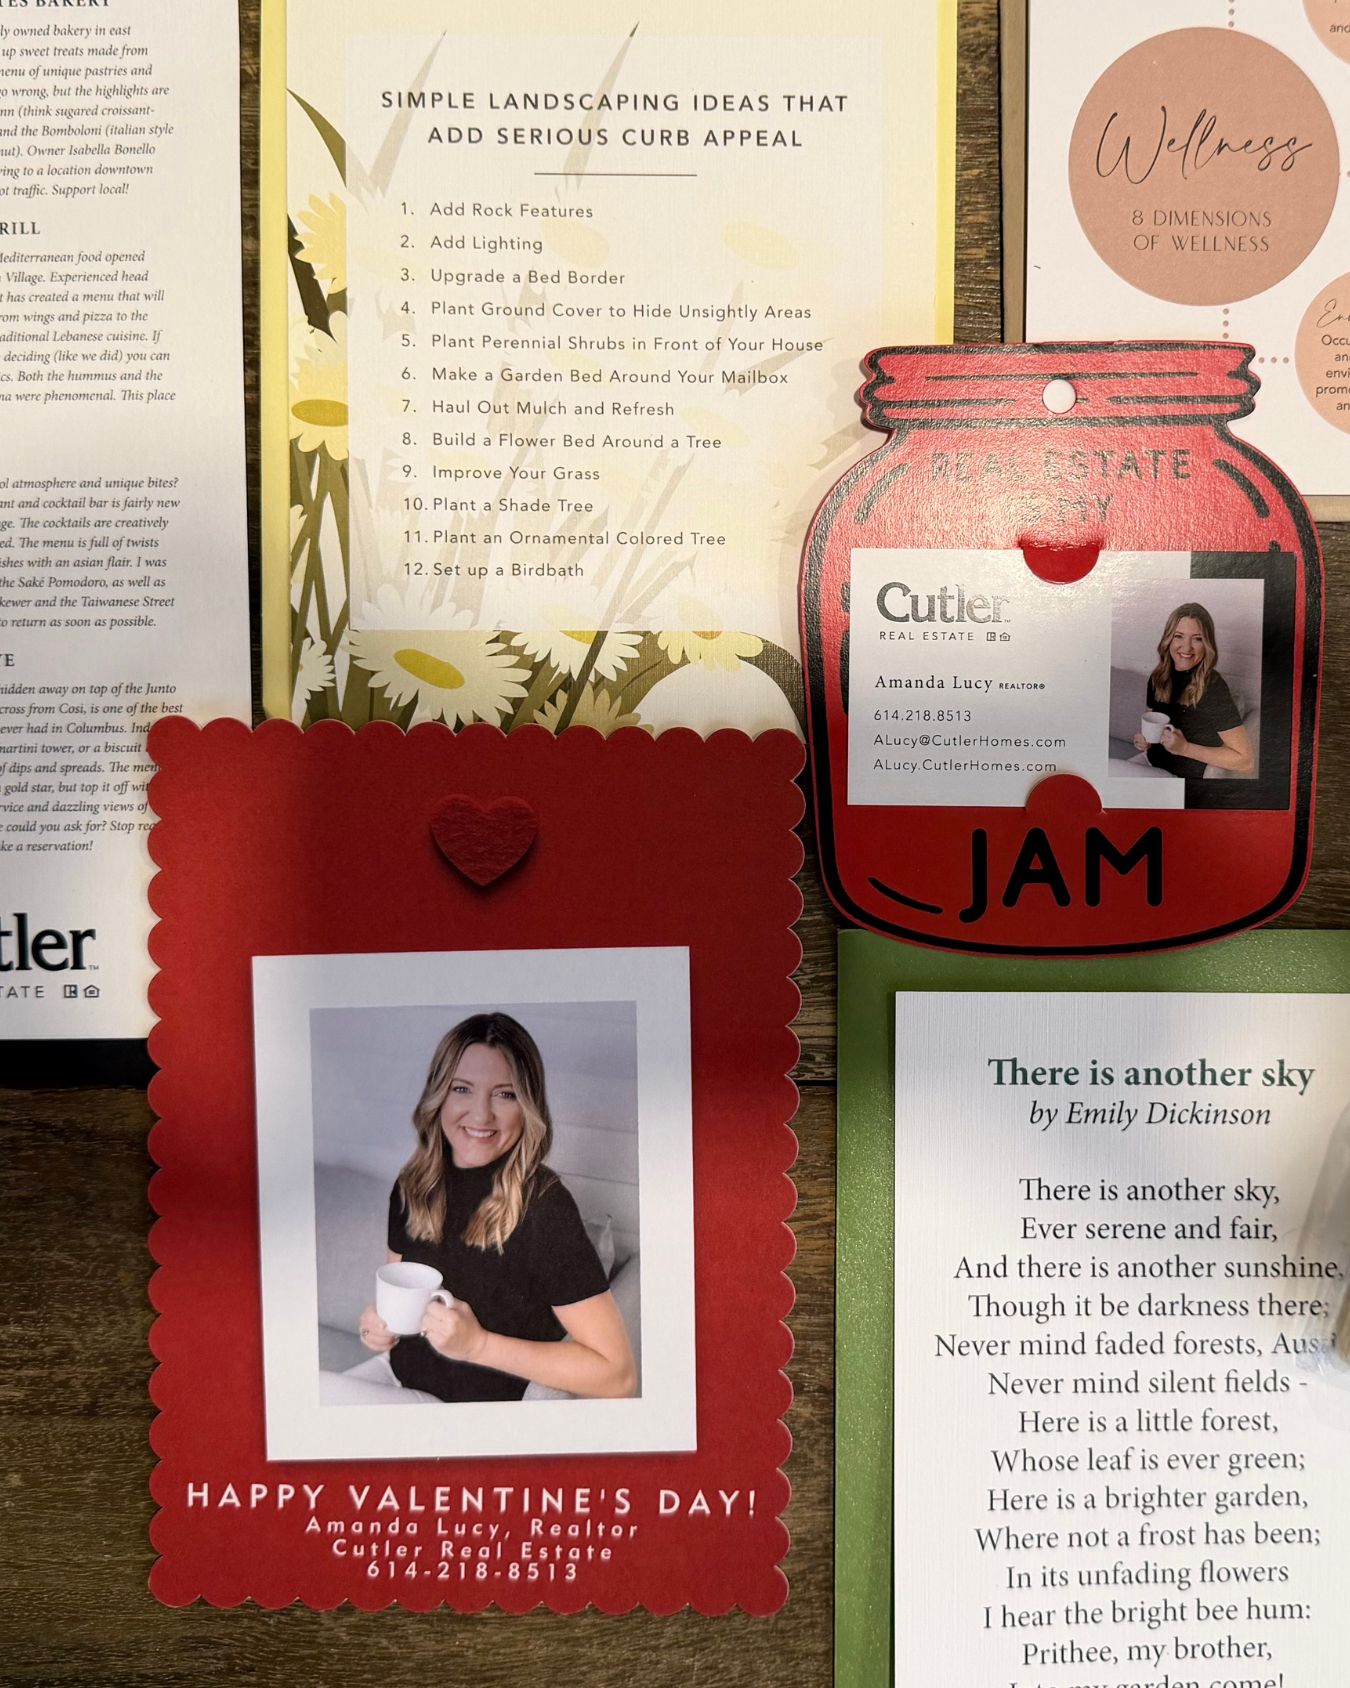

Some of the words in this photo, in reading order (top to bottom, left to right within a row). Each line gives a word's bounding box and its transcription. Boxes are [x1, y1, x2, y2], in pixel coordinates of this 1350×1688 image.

[2, 47, 16, 60] up
[19, 46, 50, 57] sweet
[53, 46, 84, 56] treats
[87, 45, 119, 56] made
[119, 44, 148, 59] from
[381, 90, 474, 109] SIMPLE
[489, 92, 678, 111] LANDSCAPING
[693, 94, 769, 112] IDEAS
[782, 94, 847, 112] THAT
[427, 126, 482, 144] ADD
[497, 127, 608, 145] SERIOUS
[622, 128, 689, 146] CURB
[703, 129, 802, 147] APPEAL
[1095, 105, 1313, 184] Wellness
[401, 201, 414, 215] 1.
[429, 201, 464, 216] Add
[472, 202, 513, 217] Rock
[520, 203, 593, 218] Features
[1131, 208, 1144, 225] 8
[1153, 209, 1271, 227] DIMENSIONS
[400, 234, 414, 248] 2.
[430, 234, 465, 249] Add
[473, 235, 542, 254] Lighting
[1133, 233, 1159, 251] OF
[1171, 235, 1269, 252] WELLNESS
[400, 267, 415, 281] 3.
[431, 268, 505, 286] Upgrade
[512, 273, 521, 283] a
[528, 269, 560, 284] Bed
[568, 270, 625, 284] Border
[400, 300, 415, 314] 4.
[431, 300, 474, 315] Plant
[481, 301, 545, 316] Ground
[552, 302, 602, 317] Cover
[608, 305, 626, 317] to
[633, 303, 671, 318] Hide
[679, 303, 758, 322] Unsightly
[764, 304, 811, 318] Areas
[3, 350, 51, 365] deciding
[53, 349, 78, 363] (like
[81, 353, 97, 361] we
[99, 349, 123, 363] did)
[125, 352, 147, 364] you
[149, 352, 170, 361] can
[402, 464, 417, 478] 9.
[433, 465, 502, 482] Improve
[509, 465, 546, 480] Your
[553, 466, 600, 480] Grass
[933, 450, 1027, 482] REAL
[1044, 449, 1191, 482] ESTATE
[11, 477, 77, 492] atmosphere
[79, 476, 102, 488] and
[105, 477, 144, 491] unique
[147, 476, 179, 488] bites?
[404, 497, 428, 510] 10.
[433, 496, 476, 511] Plant
[483, 501, 492, 511] a
[498, 497, 550, 512] Shade
[557, 498, 593, 512] Tree
[1057, 494, 1114, 522] MY
[404, 562, 428, 575] 12.
[433, 562, 461, 576] Set
[467, 566, 488, 579] up
[495, 566, 504, 576] a
[511, 562, 583, 576] Birdbath
[34, 595, 57, 607] and
[59, 595, 77, 607] the
[81, 596, 140, 607] Taiwanese
[142, 595, 175, 607] Street
[876, 581, 1010, 623] Cutler
[11, 618, 46, 627] return
[49, 618, 62, 627] as
[64, 618, 91, 627] soon
[94, 618, 107, 627] as
[109, 614, 156, 630] possible.
[879, 630, 914, 640] REAL
[922, 631, 973, 641] ESTATE
[38, 686, 69, 697] away
[71, 686, 86, 694] on
[89, 684, 108, 697] top
[110, 682, 124, 697] of
[125, 682, 143, 694] the
[145, 682, 176, 695] Junto
[874, 674, 945, 689] Amanda
[952, 675, 993, 693] Lucy
[873, 709, 971, 722] 614.218.8513
[873, 733, 1066, 749] ALucy@CutlerHomes.com
[873, 758, 1057, 774] ALucy.CutlerHomes.com
[958, 826, 1162, 923] JAM
[987, 1056, 1079, 1086] There
[1089, 1058, 1114, 1086] is
[1124, 1057, 1252, 1086] another
[1261, 1058, 1315, 1096] sky
[1029, 1099, 1058, 1131] by
[1064, 1099, 1138, 1131] Emily
[1145, 1100, 1270, 1125] Dickinson
[1018, 1176, 1091, 1201] There
[1099, 1178, 1118, 1201] is
[1126, 1177, 1225, 1201] another
[1234, 1177, 1279, 1208] sky,
[1020, 1216, 1077, 1239] Ever
[1085, 1223, 1166, 1239] serene
[1174, 1215, 1221, 1239] and
[1230, 1215, 1277, 1242] fair,
[953, 1254, 1008, 1278] And
[1017, 1253, 1081, 1278] there
[1090, 1256, 1109, 1278] is
[1117, 1253, 1216, 1278] another
[1224, 1254, 1344, 1281] sunshine,
[967, 1292, 1066, 1324] Though
[1075, 1294, 1091, 1316] it
[1100, 1292, 1129, 1316] be
[1137, 1292, 1249, 1316] darkness
[1257, 1292, 1328, 1317] there;
[988, 1372, 1064, 1395] Never
[1072, 1369, 1139, 1394] mind
[1148, 1369, 1216, 1393] silent
[1225, 1368, 1290, 1393] fields
[990, 1447, 1079, 1472] Whose
[1087, 1446, 1135, 1471] leaf
[1140, 1448, 1158, 1470] is
[1167, 1453, 1220, 1470] ever
[1227, 1452, 1304, 1477] green;
[187, 1482, 324, 1510] HAPPY
[349, 1484, 630, 1515] VALENTINE'S
[659, 1489, 755, 1516] DAY!
[987, 1488, 1048, 1511] Here
[1057, 1488, 1075, 1510] is
[1084, 1493, 1096, 1509] a
[1105, 1484, 1206, 1516] brighter
[1214, 1483, 1308, 1515] garden,
[305, 1517, 418, 1536] Amanda
[437, 1518, 511, 1541] Lucy,
[530, 1518, 637, 1538] Realtor
[332, 1538, 423, 1557] Cutler
[441, 1540, 503, 1559] Real
[521, 1541, 613, 1560] Estate
[367, 1560, 576, 1581] 614-218-8513
[1007, 1566, 1031, 1589] In
[1041, 1565, 1068, 1587] its
[1078, 1560, 1191, 1591] unfading
[1200, 1559, 1289, 1583] flowers
